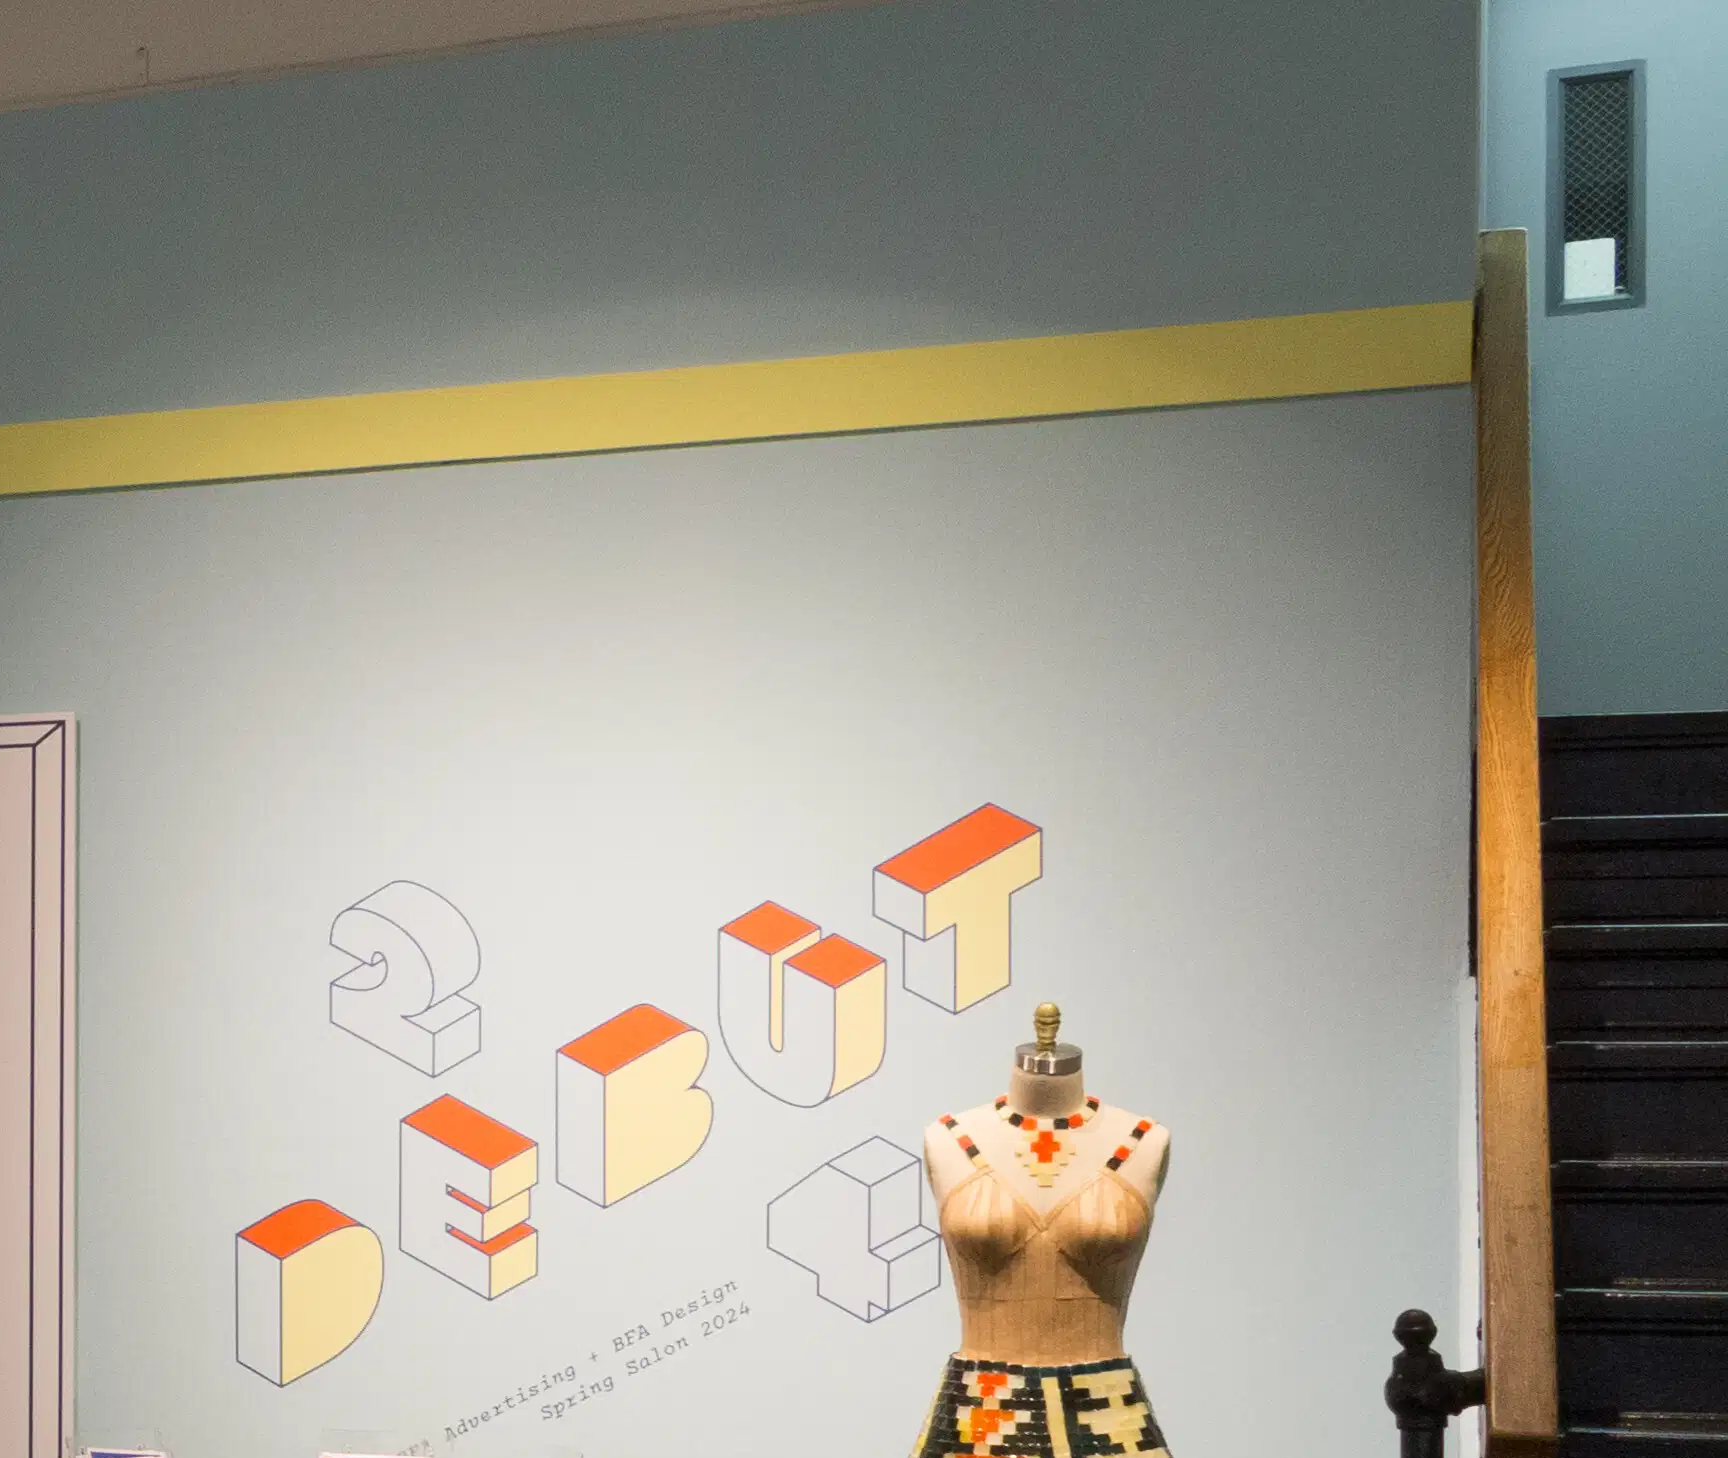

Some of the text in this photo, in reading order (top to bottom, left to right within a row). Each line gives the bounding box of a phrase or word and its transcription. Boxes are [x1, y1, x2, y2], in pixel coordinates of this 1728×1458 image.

[444, 1364, 576, 1442] Advertising
[613, 1324, 650, 1352] BFA
[661, 1279, 740, 1327] Design
[540, 1300, 751, 1421] Spring Salon 2024
